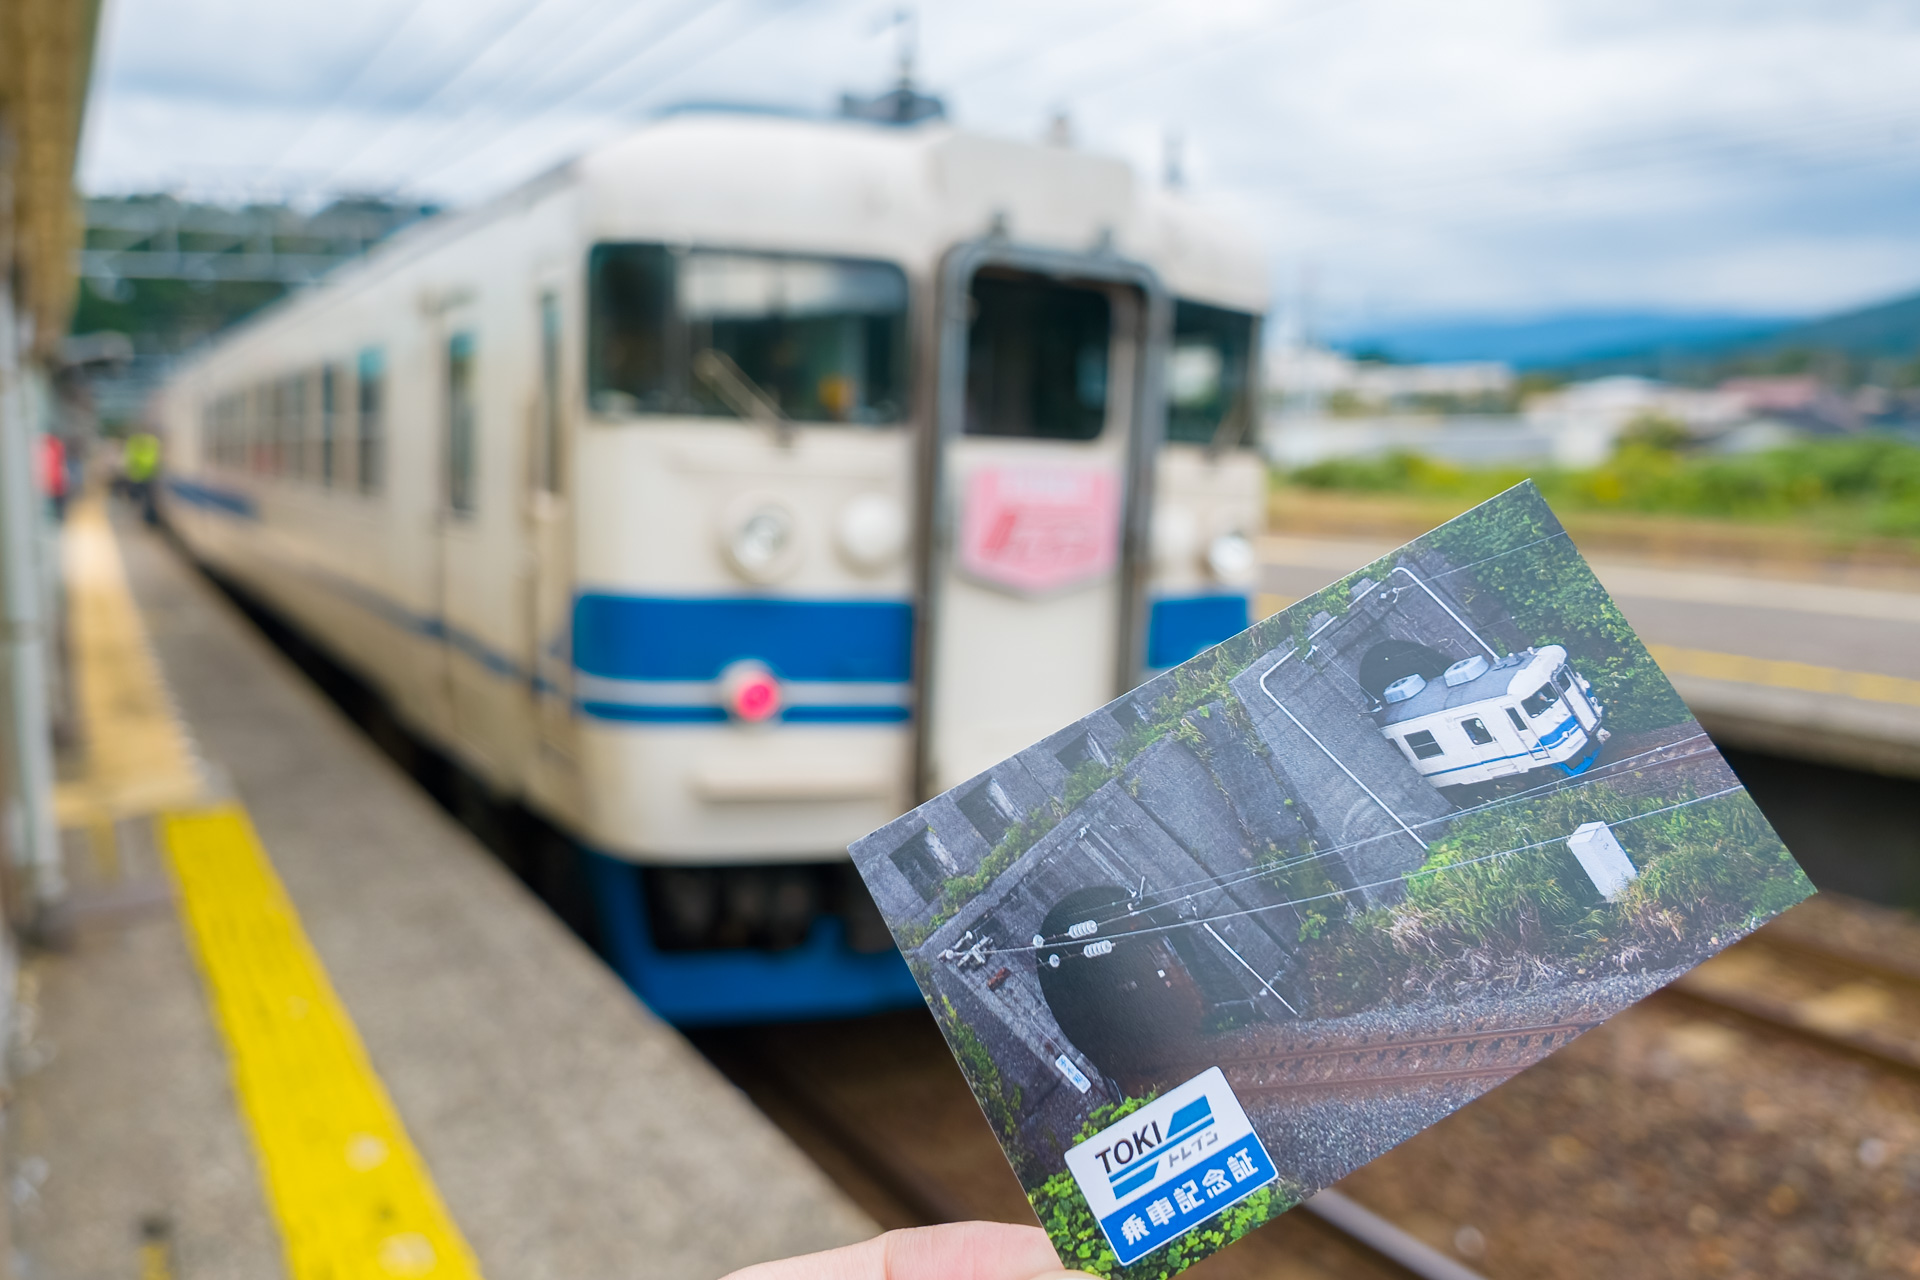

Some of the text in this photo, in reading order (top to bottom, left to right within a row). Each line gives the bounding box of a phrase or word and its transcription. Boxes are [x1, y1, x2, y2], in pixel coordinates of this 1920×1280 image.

[1095, 1120, 1163, 1173] TOKI
[1168, 1132, 1219, 1168] トレイン
[1120, 1147, 1259, 1246] 乗車記念証
